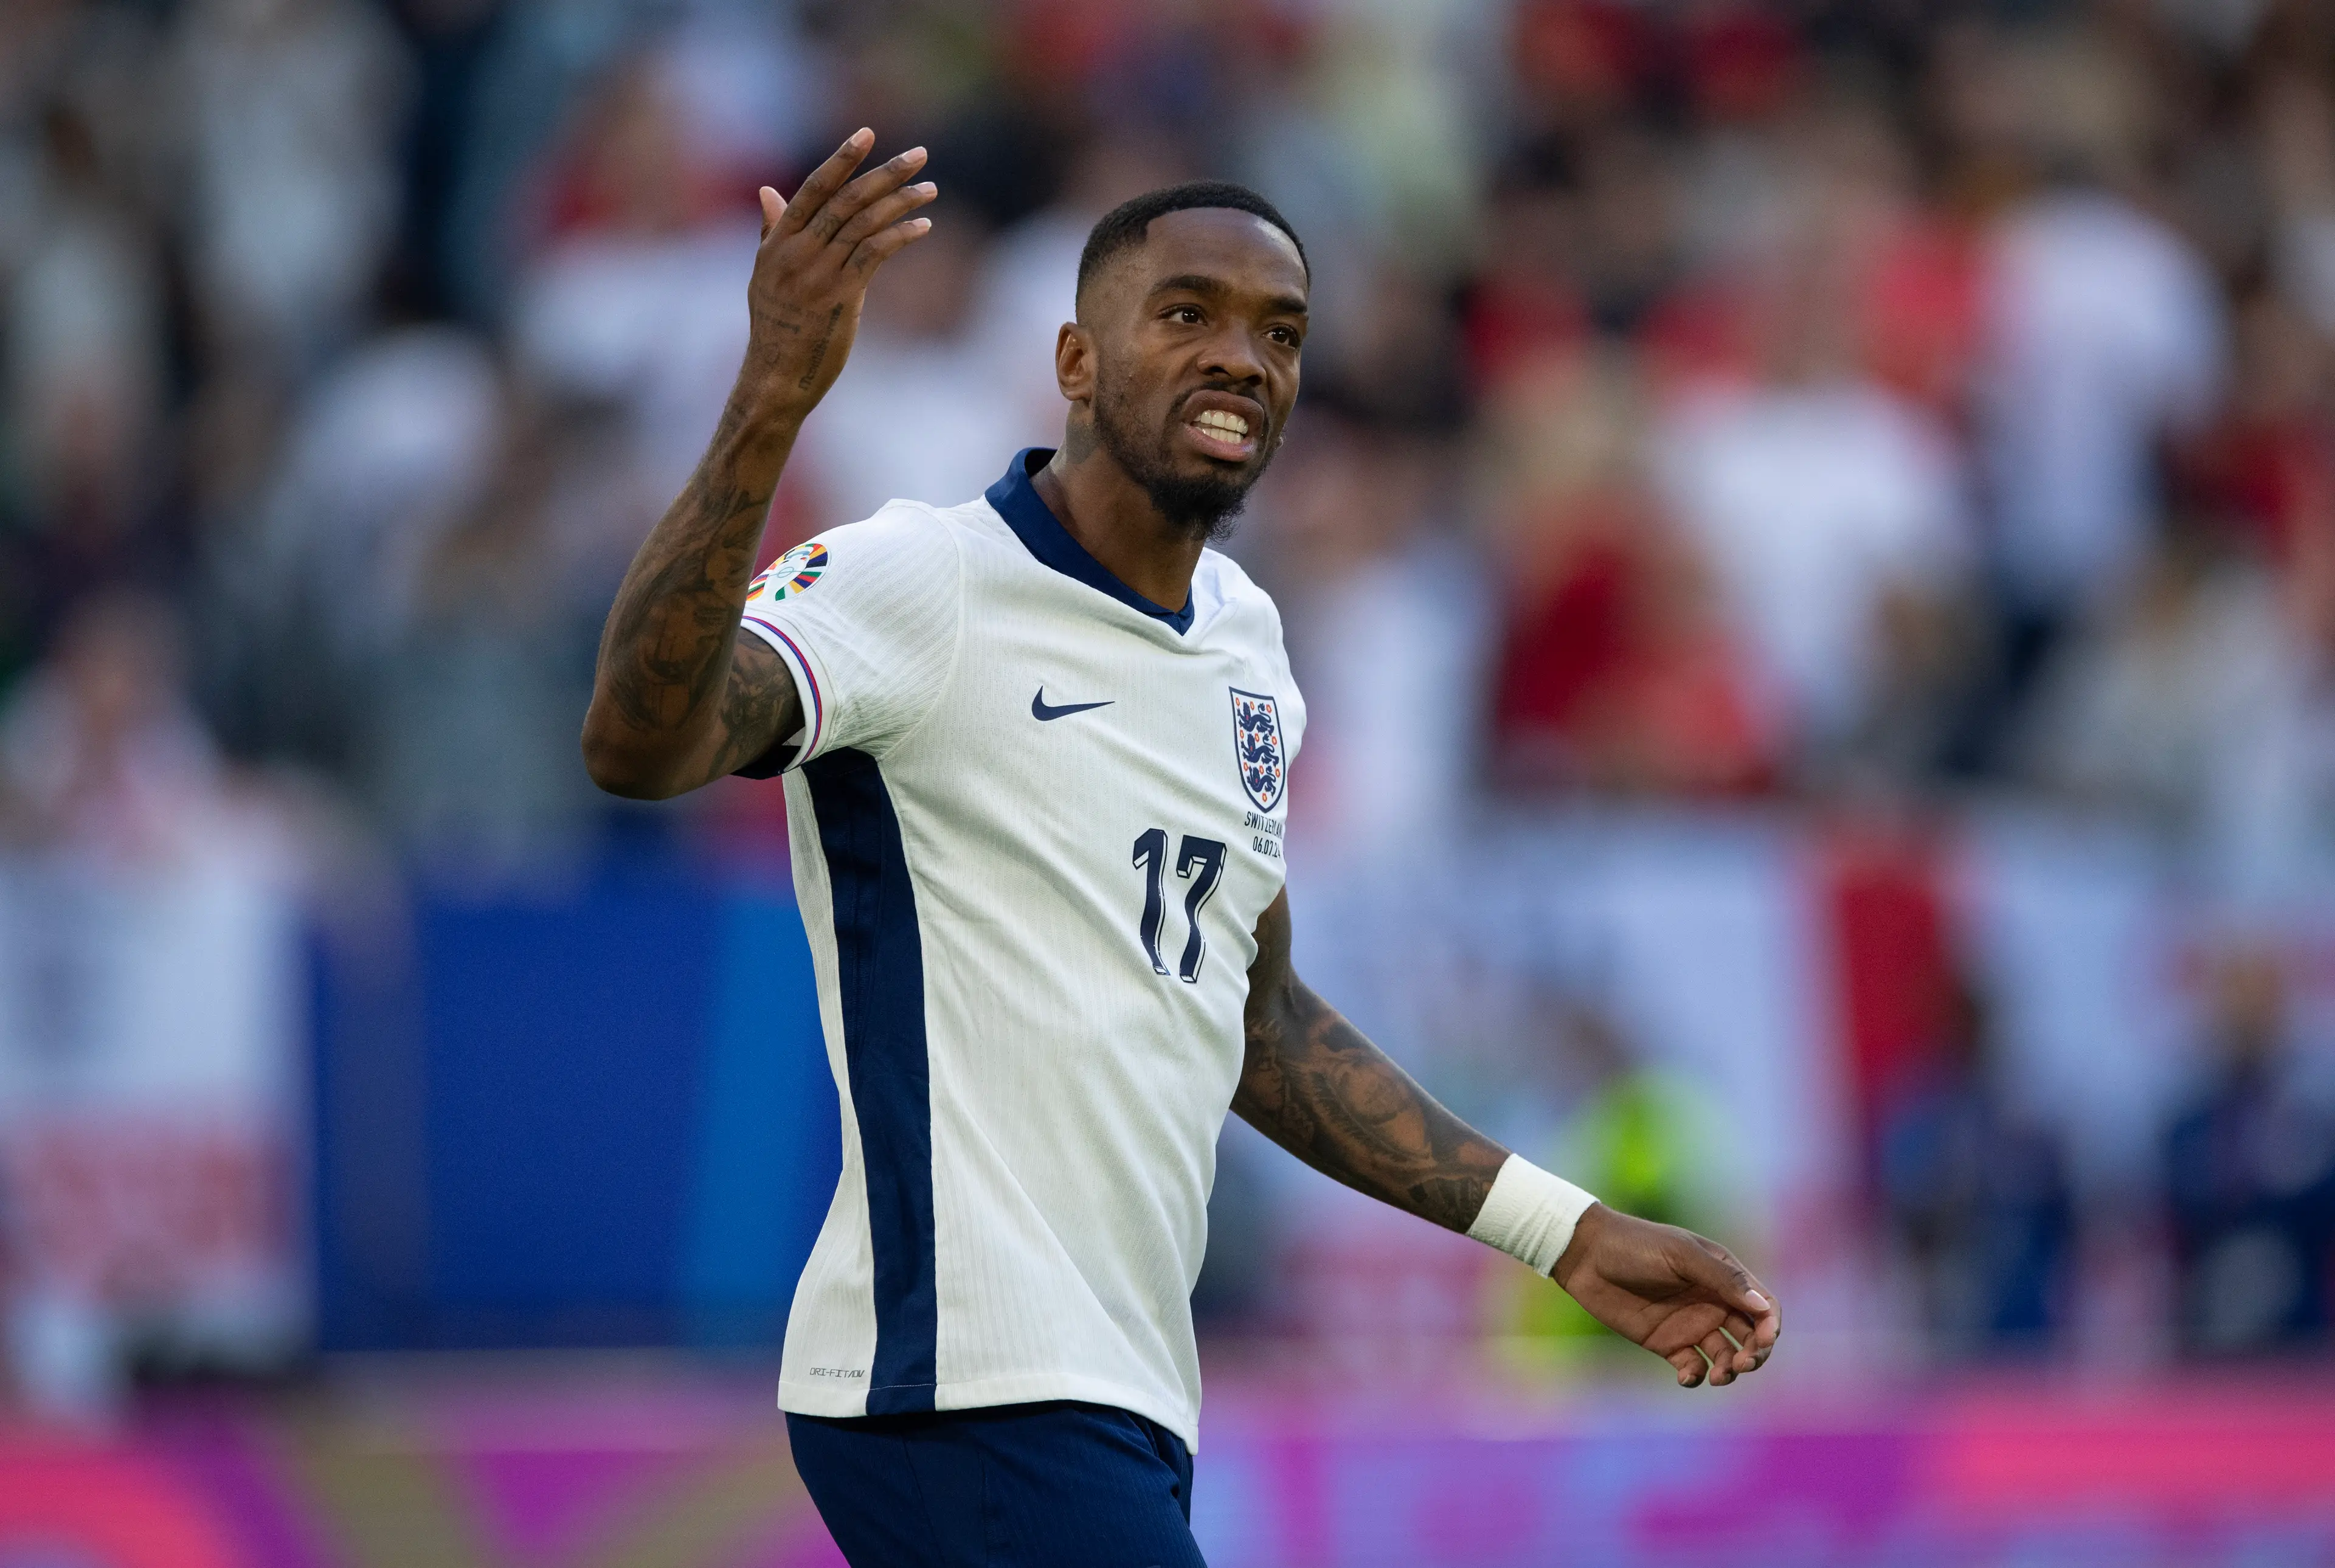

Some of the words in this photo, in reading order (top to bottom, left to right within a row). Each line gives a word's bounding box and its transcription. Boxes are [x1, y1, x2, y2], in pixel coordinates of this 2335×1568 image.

[1244, 810, 1283, 840] SWITZERLA
[1253, 835, 1281, 858] 06.07.24
[1132, 828, 1227, 984] 17
